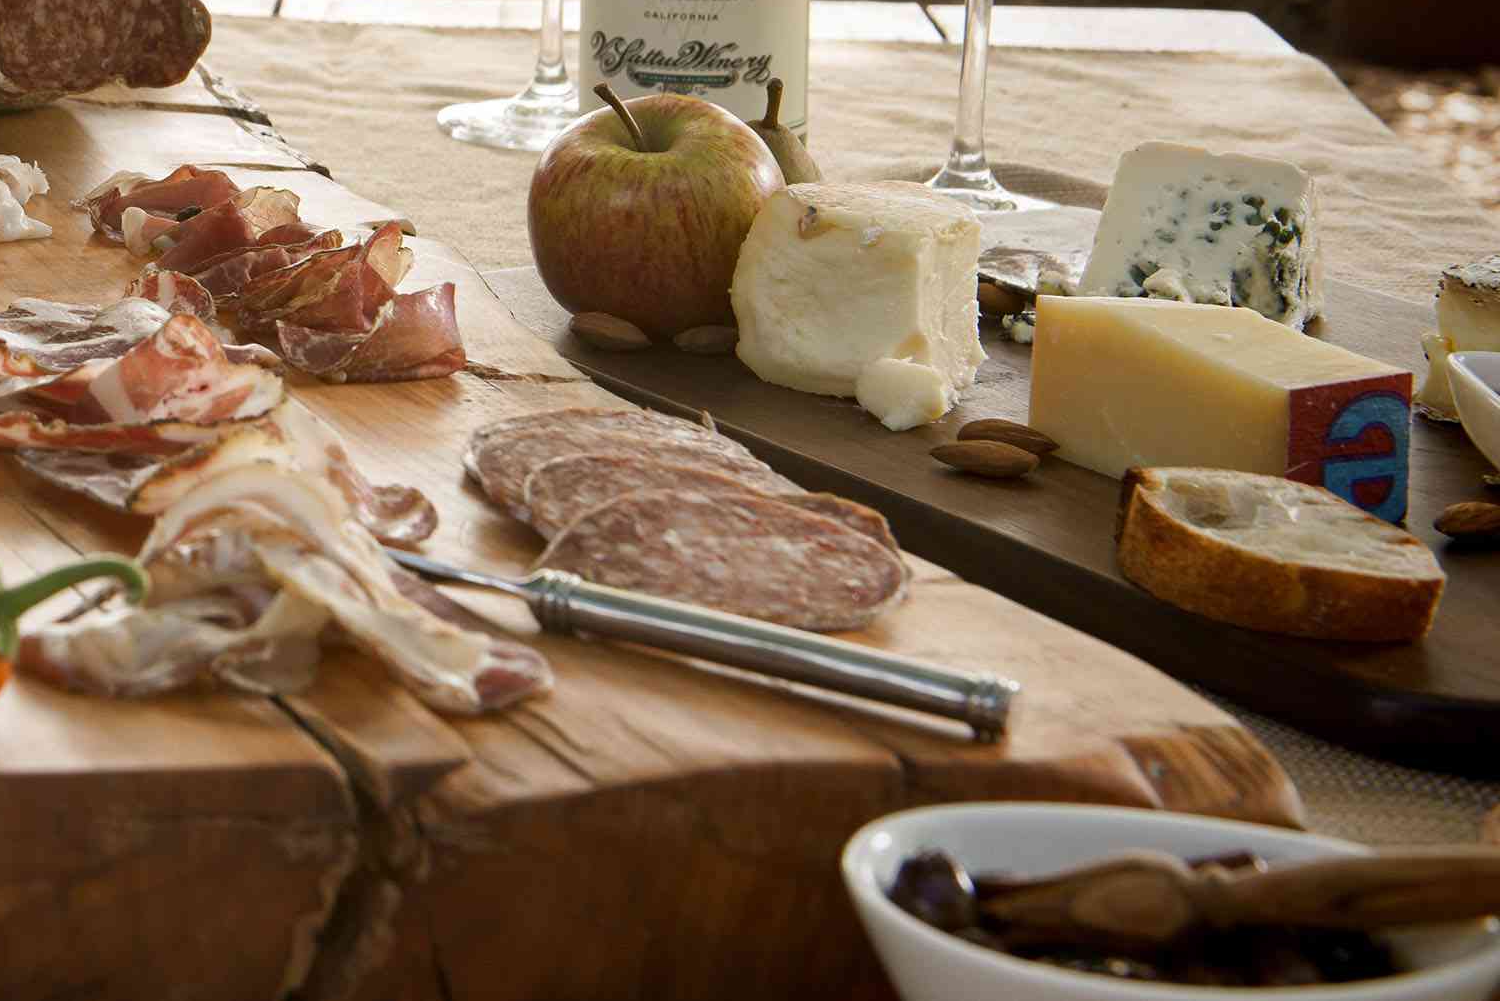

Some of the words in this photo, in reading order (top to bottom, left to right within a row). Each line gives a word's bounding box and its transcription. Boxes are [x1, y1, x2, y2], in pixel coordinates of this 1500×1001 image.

[643, 10, 719, 22] CALIFORNIA
[600, 37, 688, 78] Sattui
[677, 40, 773, 85] Winery
